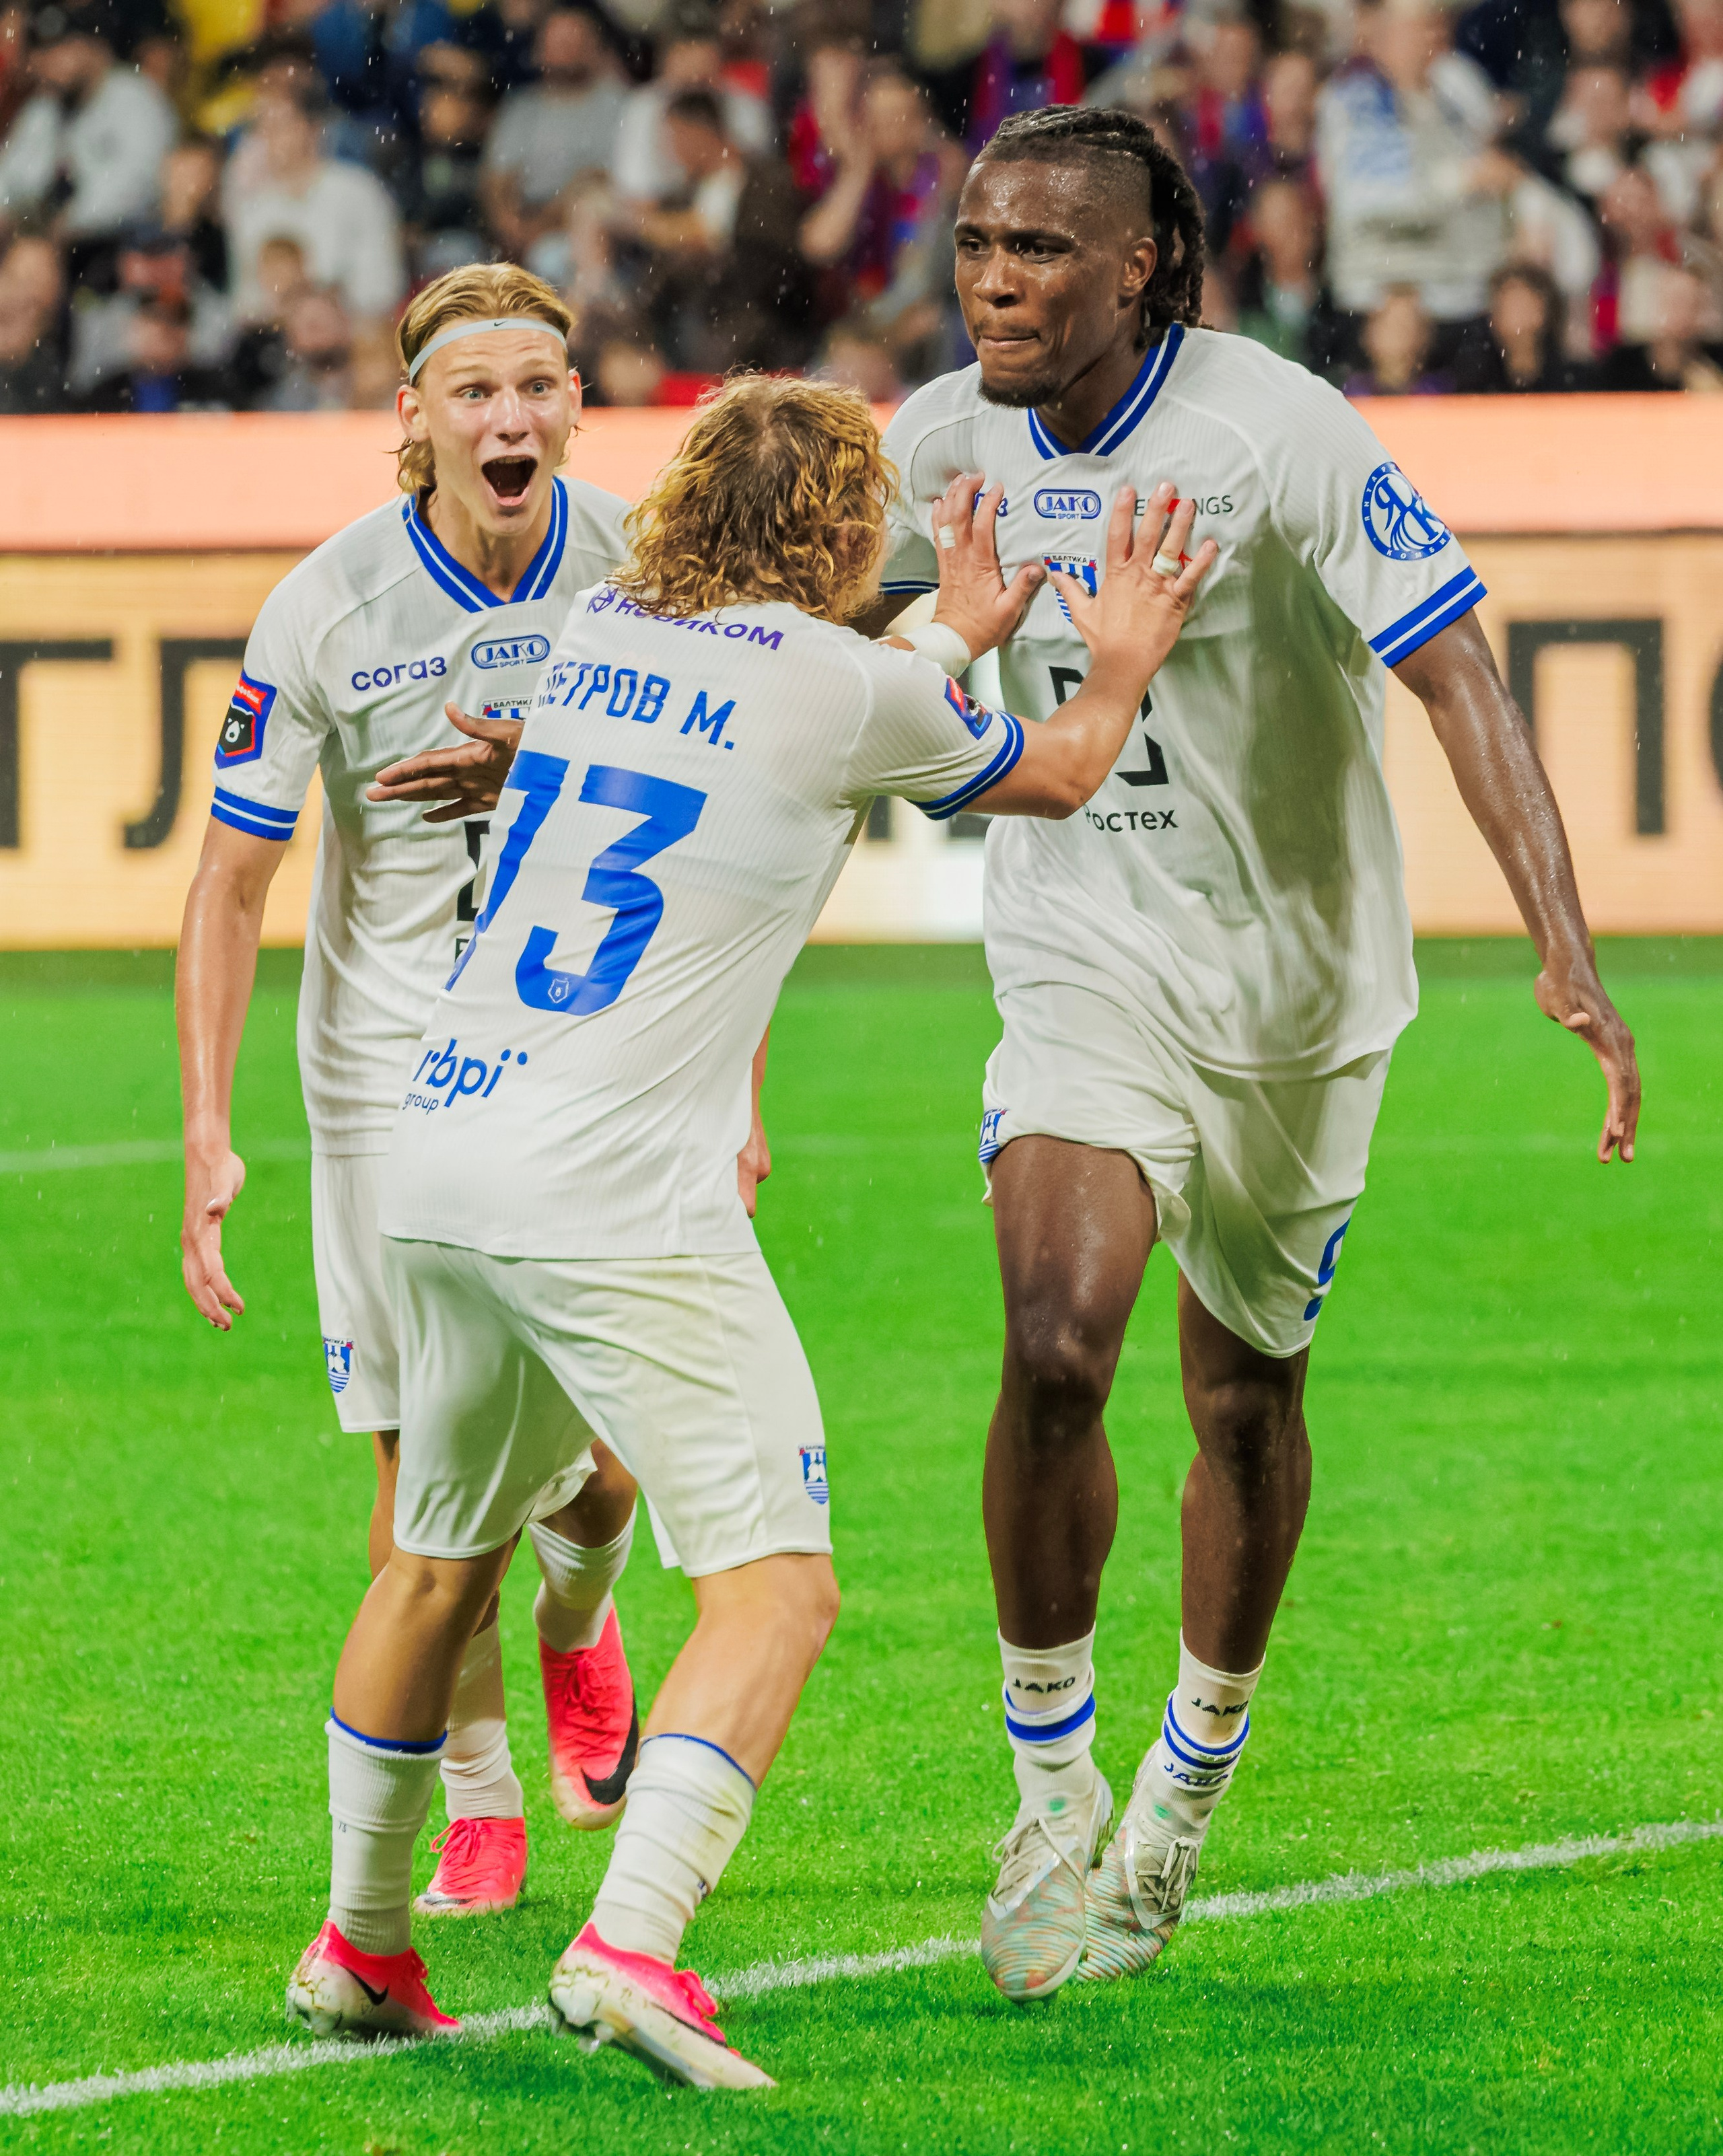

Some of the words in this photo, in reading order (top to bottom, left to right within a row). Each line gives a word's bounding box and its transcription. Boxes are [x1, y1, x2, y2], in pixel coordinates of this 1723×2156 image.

[1041, 496, 1094, 512] JAKO
[1052, 554, 1088, 564] БАЛТИКА
[481, 640, 544, 663] JAKO
[499, 659, 524, 668] SPORT
[679, 689, 736, 750] М.
[442, 749, 708, 1016] 73
[402, 1092, 439, 1115] group
[1012, 1676, 1076, 1693] JAKO
